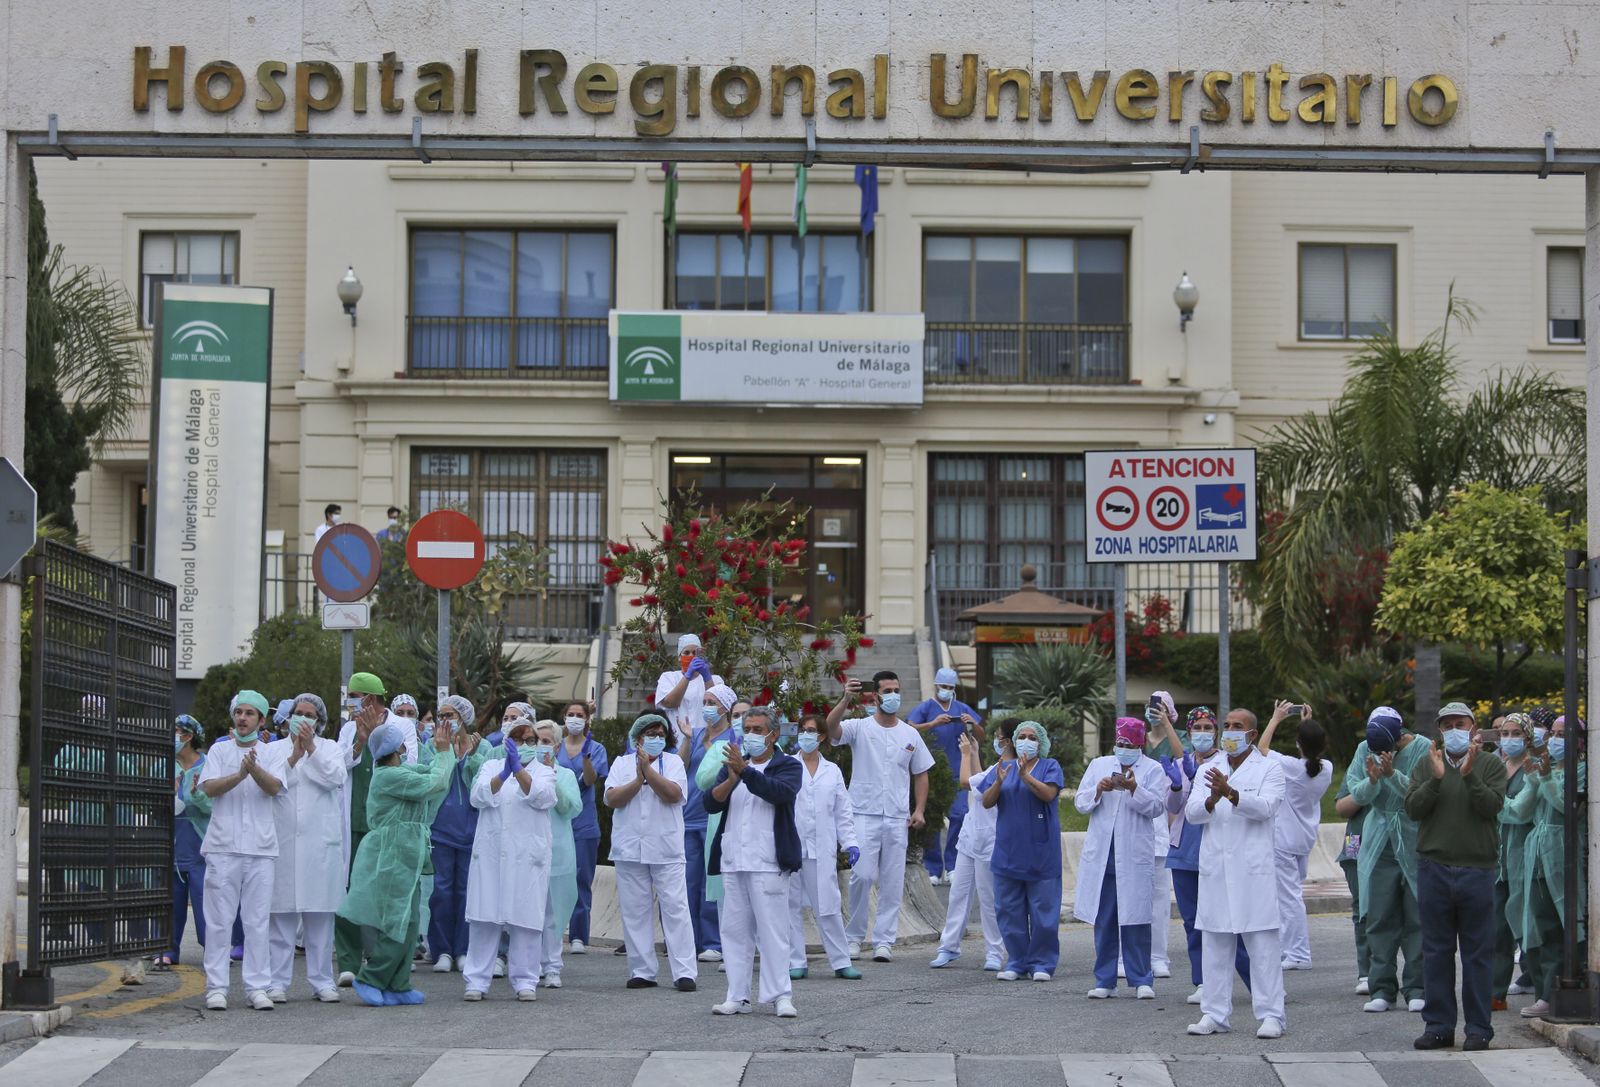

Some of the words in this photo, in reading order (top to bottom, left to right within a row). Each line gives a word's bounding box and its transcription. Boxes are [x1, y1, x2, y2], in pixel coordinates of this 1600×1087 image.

[132, 45, 479, 132] Hospital
[519, 48, 889, 137] Regional
[929, 53, 1459, 127] Universitario
[688, 338, 747, 354] Hospital
[752, 339, 813, 355] Regional
[818, 340, 911, 354] Universitario
[743, 375, 791, 387] Pabellón
[820, 378, 865, 389] Hospital
[868, 378, 912, 389] General
[837, 358, 854, 370] de
[859, 358, 910, 375] Málaga
[185, 388, 205, 441] Málaga
[204, 388, 221, 448] General
[184, 447, 200, 465] de
[1108, 457, 1234, 478] ATENCION
[202, 454, 220, 518] Hospital
[181, 470, 199, 551] Universitario
[1156, 497, 1180, 518] 20
[1095, 537, 1133, 555] ZONA
[1139, 535, 1239, 554] HOSPITALARIA
[180, 557, 199, 612] Regional
[178, 618, 197, 670] Hospital
